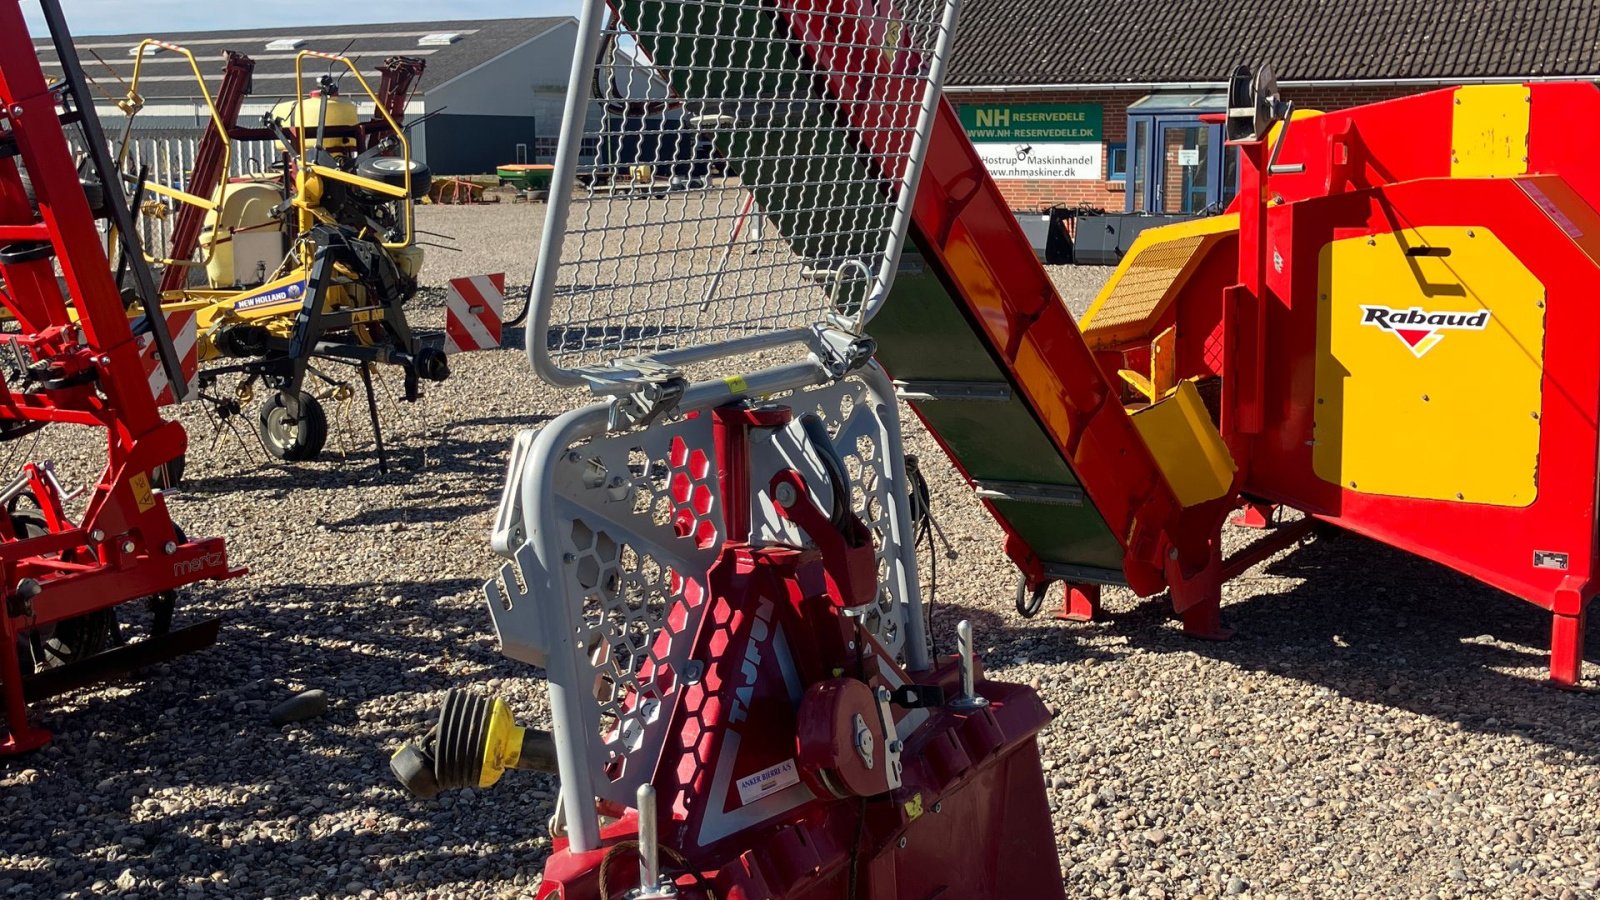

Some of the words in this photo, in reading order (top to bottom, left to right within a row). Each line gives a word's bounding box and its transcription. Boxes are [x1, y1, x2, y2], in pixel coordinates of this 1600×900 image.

[976, 109, 1010, 127] NH
[1013, 112, 1085, 122] RESERVEDELE
[967, 128, 1093, 138] WWW.NH-RESERVEDELE.DK
[981, 156, 1018, 166] Hostrup
[1027, 155, 1093, 165] Maskinhandel
[988, 167, 1076, 177] ww.nhmaskiner.dk
[238, 299, 255, 308] NEW
[255, 292, 287, 305] HOLLAND
[1364, 307, 1488, 329] Rabaud
[173, 551, 223, 577] mertz
[727, 594, 775, 724] TAJFUN
[741, 775, 762, 788] ANKER
